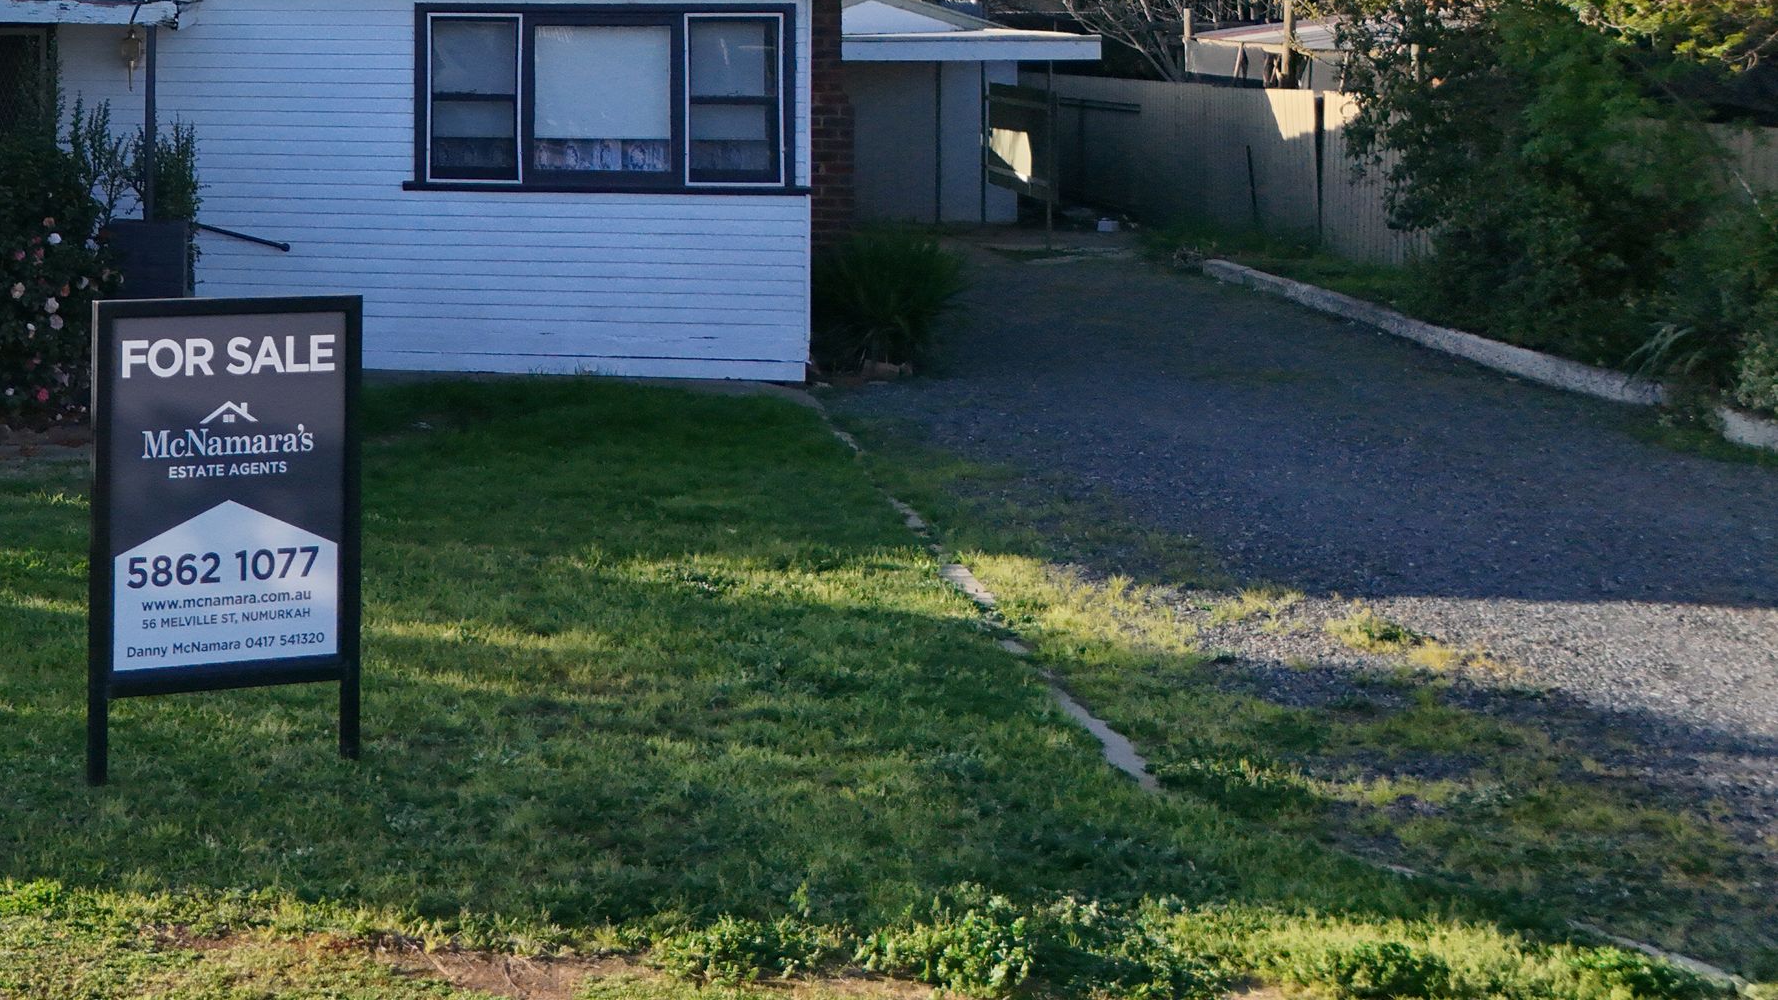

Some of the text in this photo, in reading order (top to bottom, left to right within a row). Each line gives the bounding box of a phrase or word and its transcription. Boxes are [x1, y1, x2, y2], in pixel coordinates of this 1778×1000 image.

[121, 334, 336, 379] FOR SALE
[141, 423, 314, 459] McNamara's
[168, 460, 288, 479] ESTATE AGENTS
[126, 545, 320, 589] 5862 1077
[141, 590, 312, 612] www.mcnamara.com.au
[141, 607, 311, 630] 56 MELVILLE ST, NUMURKAH
[126, 631, 326, 658] Danny McNamara 0417 541320
